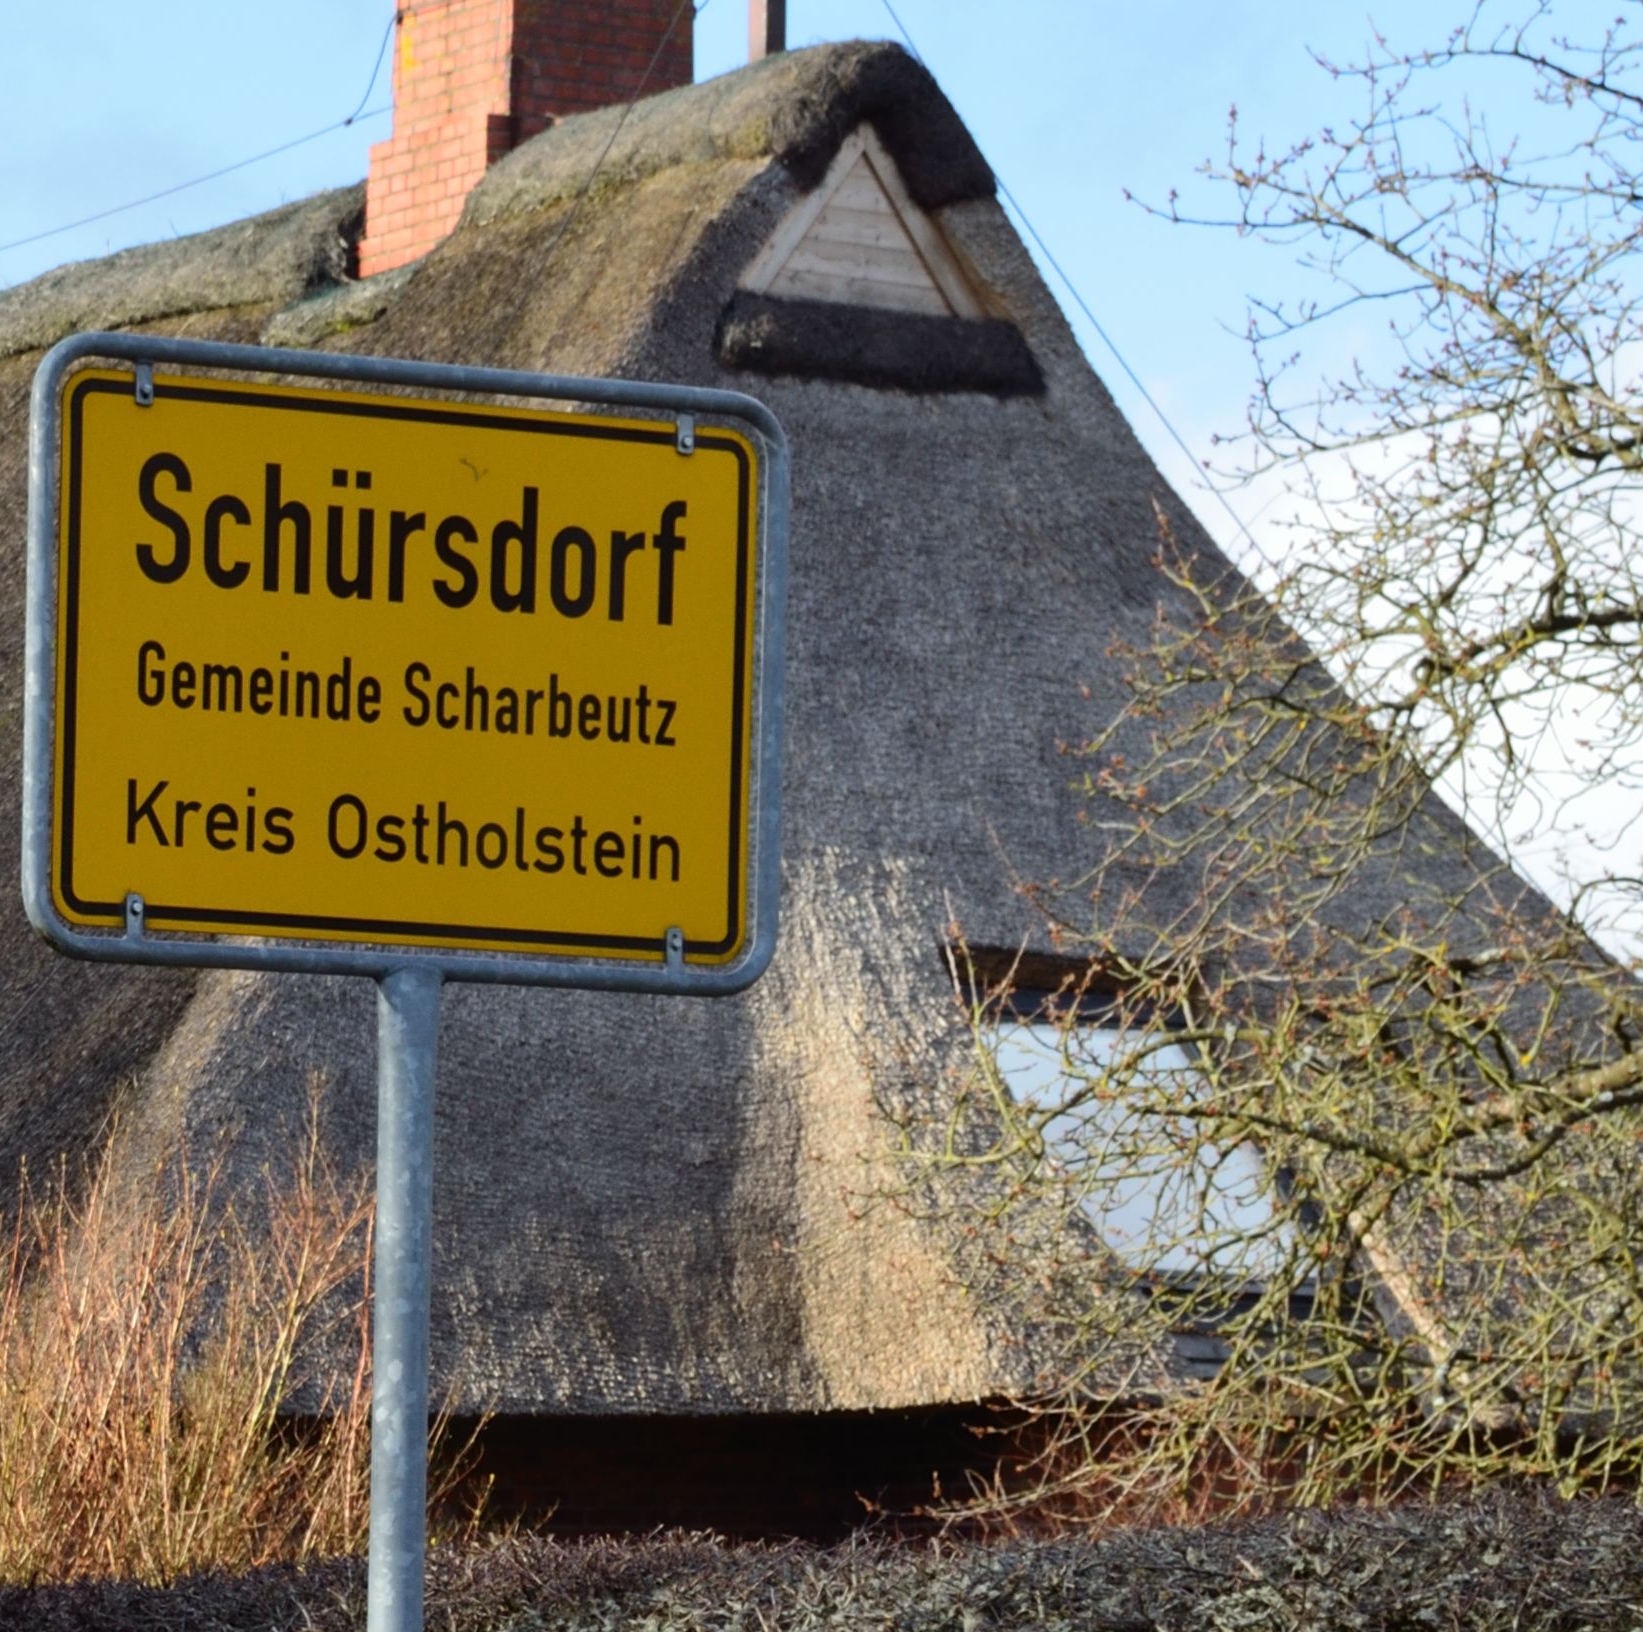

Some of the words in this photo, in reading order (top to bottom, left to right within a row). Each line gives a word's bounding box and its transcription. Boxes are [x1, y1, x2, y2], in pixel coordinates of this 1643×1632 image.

[135, 452, 688, 625] Schürsdorf
[137, 641, 382, 722] Gemeinde
[403, 662, 677, 747] Scharbeutz
[126, 778, 296, 855] Kreis
[327, 794, 682, 882] Ostholstein
